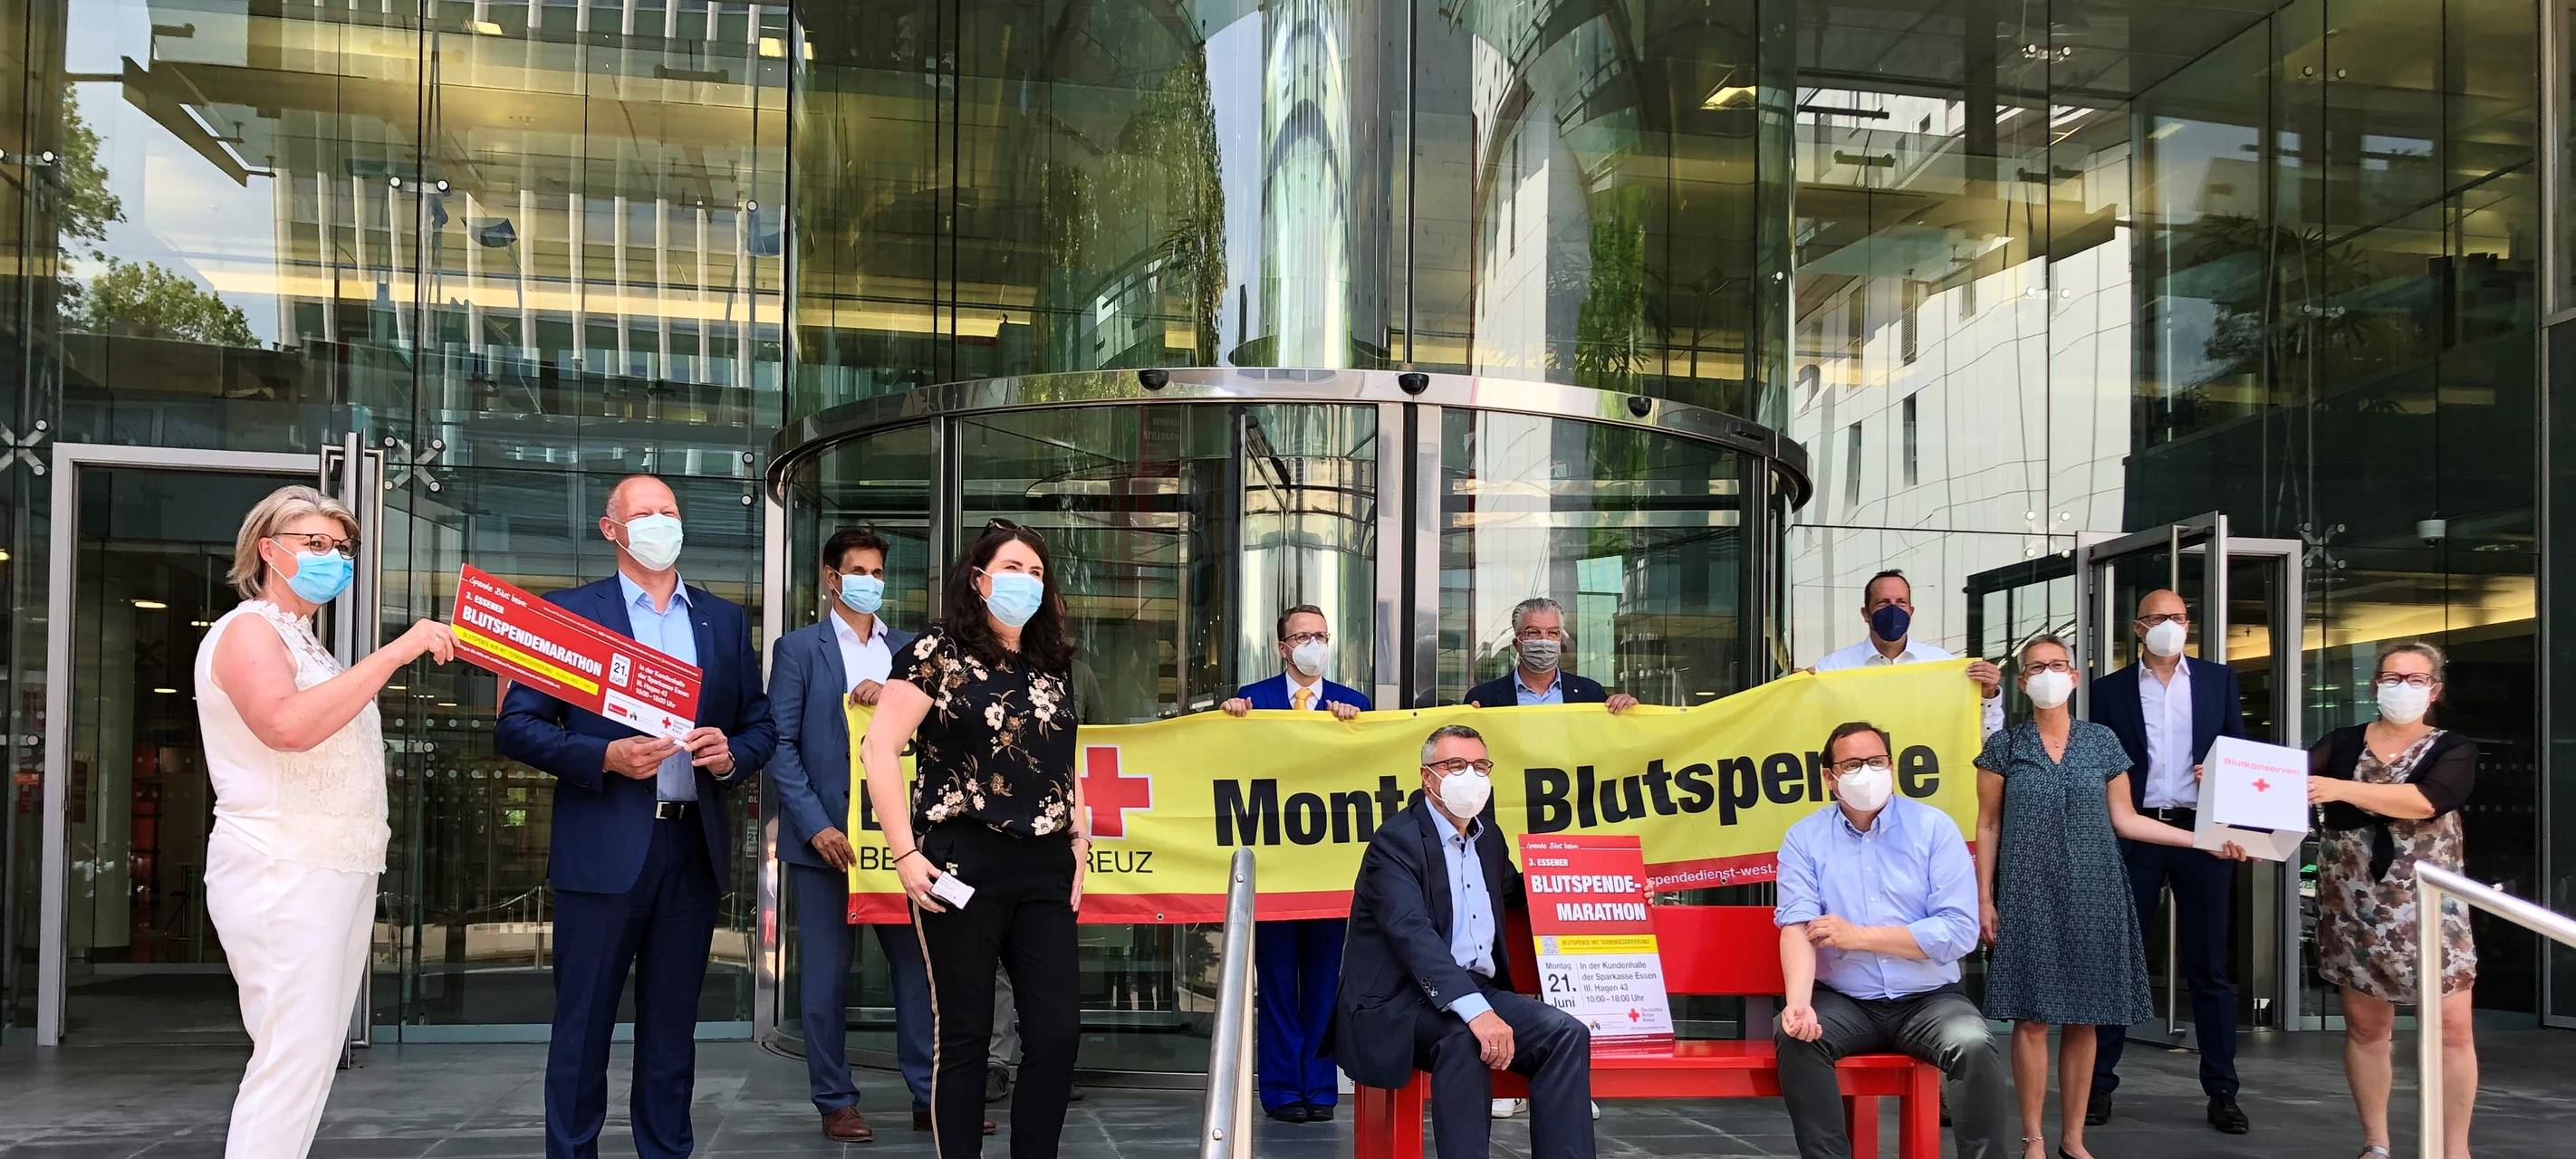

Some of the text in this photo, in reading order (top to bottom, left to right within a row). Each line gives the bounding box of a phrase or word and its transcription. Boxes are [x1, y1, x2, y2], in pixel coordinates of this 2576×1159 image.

[465, 591, 473, 601] 3.
[462, 605, 603, 677] BLUTSPENDEMARATHON
[613, 662, 628, 677] 21.
[645, 666, 654, 674] der
[611, 675, 625, 685] Juni
[647, 675, 674, 692] Sparkasse
[674, 687, 689, 698] Essen
[644, 683, 661, 694] Hagen
[666, 700, 677, 709] Uhr
[2224, 757, 2301, 776] Blutkonserven
[1523, 732, 1939, 834] Blutspene
[1526, 841, 1547, 850] Spende
[1549, 841, 1563, 849] Blut
[1086, 850, 1153, 873] REUZ
[1528, 857, 1569, 867] 3. ESSENER
[1648, 863, 1778, 887] spendedienst-west.
[1531, 875, 1641, 893] BLUTSPENDE-
[1556, 903, 1647, 921] MARATHON
[1545, 963, 1572, 971] Montag
[1602, 961, 1647, 970] Kundenhalle
[1548, 973, 1576, 992] 21.
[1593, 983, 1618, 993] Hagen
[1620, 983, 1629, 991] 43
[1595, 972, 1633, 982] Sparkasse
[1635, 972, 1657, 980] Essen
[1552, 996, 1576, 1009] Juni
[1631, 993, 1645, 1001] Uhr
